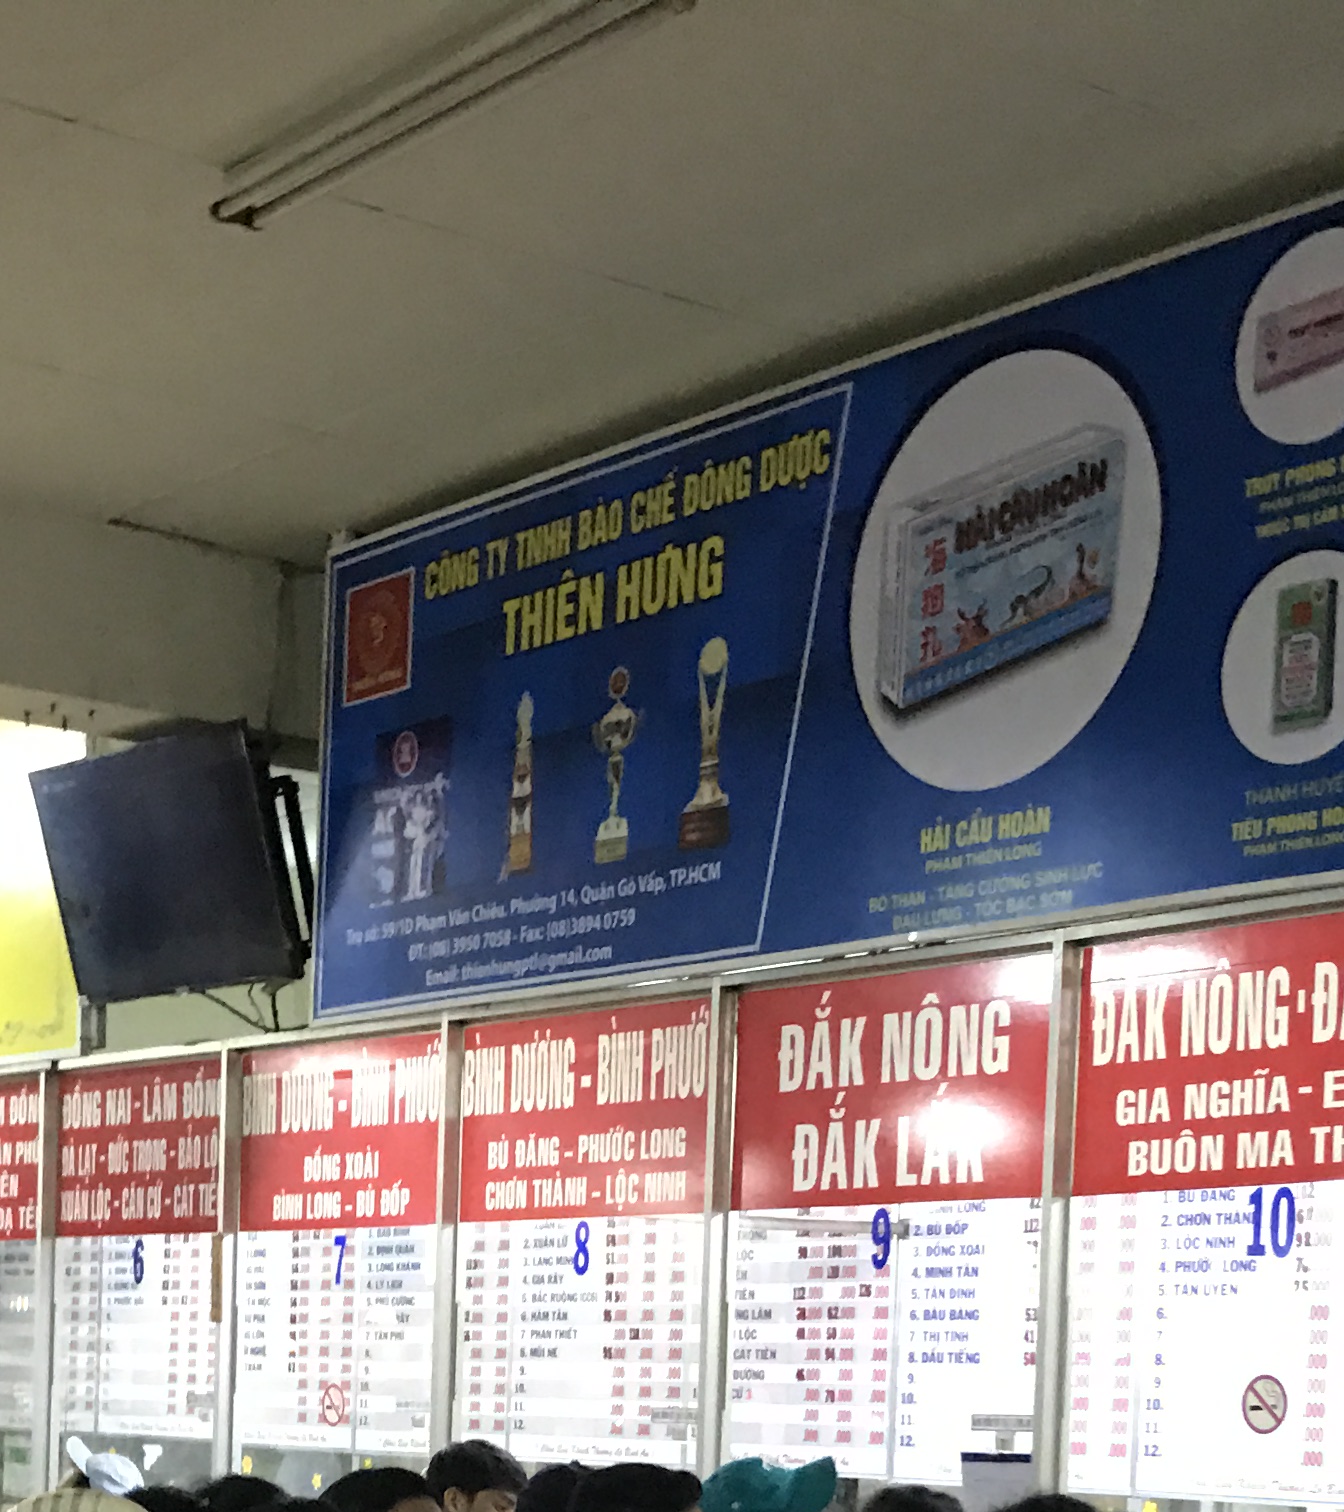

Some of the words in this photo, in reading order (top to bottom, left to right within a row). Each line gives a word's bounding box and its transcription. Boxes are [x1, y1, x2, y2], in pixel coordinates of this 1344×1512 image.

[486, 537, 508, 580] TY
[516, 516, 571, 571] TNHH
[503, 569, 604, 656] THIÊN
[669, 860, 721, 887] TP.HCM
[1180, 957, 1291, 1058] NÔNG
[880, 992, 1011, 1084] NÔNG
[106, 1086, 131, 1126] NAI
[1115, 1087, 1170, 1127] GIA
[1184, 1069, 1291, 1121] NGHĨA
[640, 1127, 686, 1161] LONG
[1127, 1129, 1224, 1176] BUÔN
[1236, 1129, 1295, 1169] MA
[307, 1192, 341, 1218] LONG
[643, 1171, 686, 1204] NINH
[574, 1220, 590, 1276] 8
[871, 1207, 891, 1270] 9
[1246, 1186, 1295, 1258] 10
[132, 1238, 144, 1284] 6
[334, 1236, 346, 1285] 7
